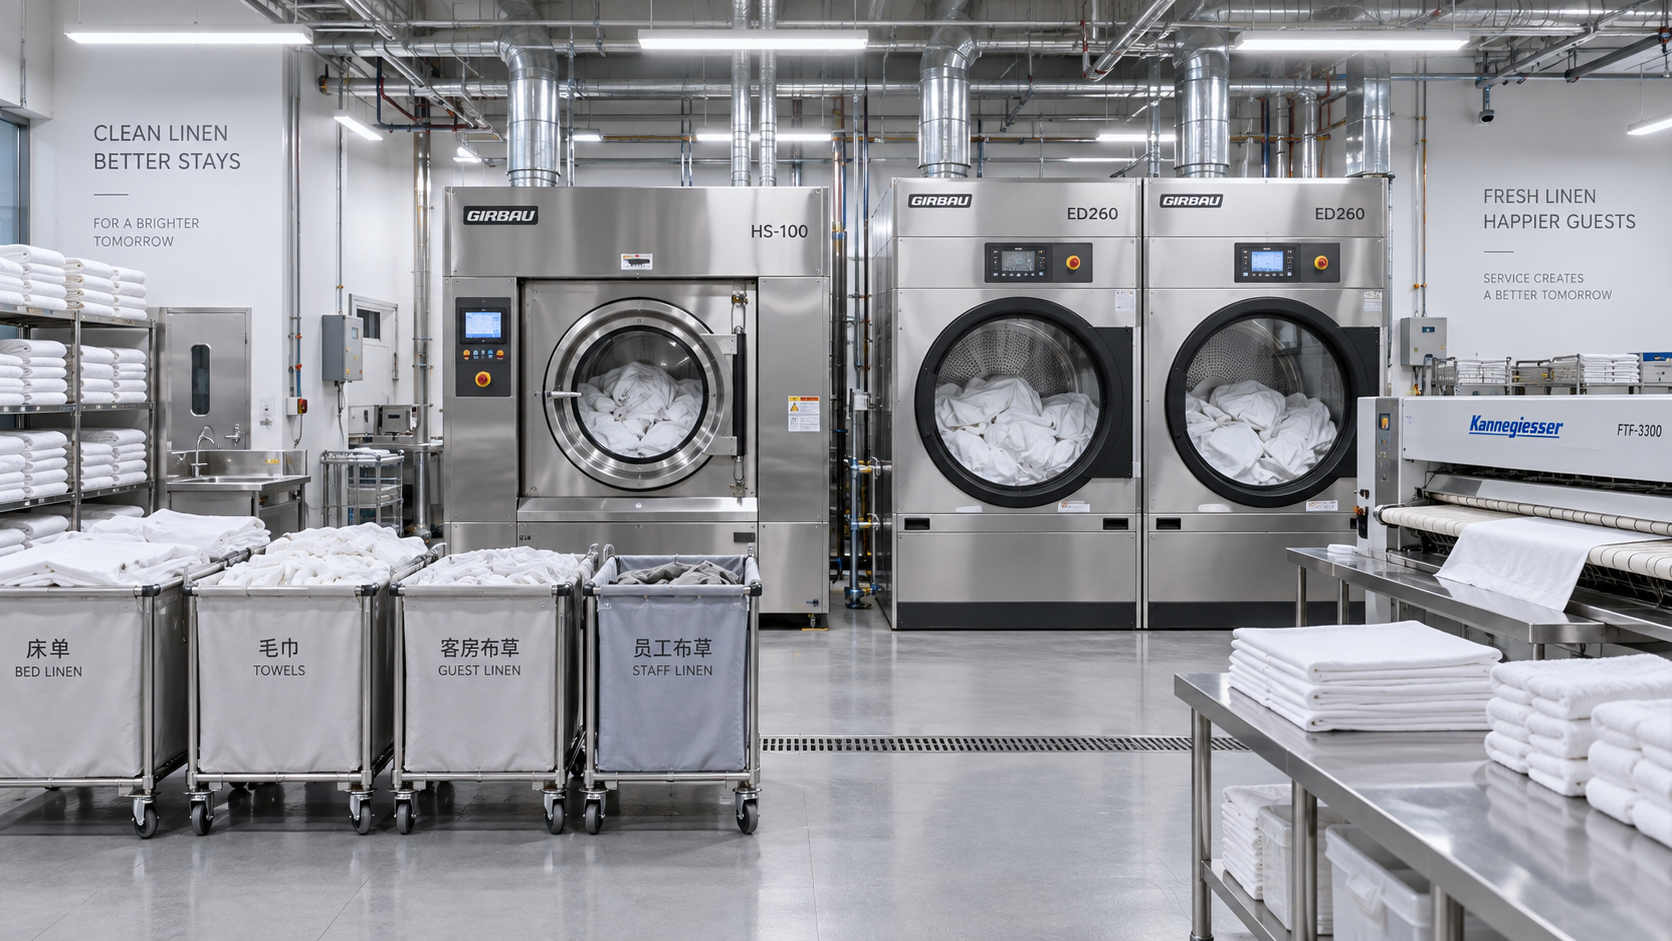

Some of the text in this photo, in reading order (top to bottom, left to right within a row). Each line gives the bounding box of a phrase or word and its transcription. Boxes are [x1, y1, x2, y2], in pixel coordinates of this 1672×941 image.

[93, 125, 227, 141] CLEAN LINEN
[94, 153, 240, 169] BETTER STAYS
[909, 196, 970, 208] GIRBAU
[1161, 196, 1221, 208] GIRBAU
[1484, 189, 1595, 203] FRESH LINEN
[465, 210, 536, 223] GIRBAU
[1067, 208, 1118, 221] ED260
[1315, 208, 1365, 221] ED260
[93, 218, 199, 229] FOR A BRIGHTER
[1484, 214, 1635, 229] HAPPIER GUESTS
[750, 224, 809, 239] HS-100
[93, 236, 174, 248] TOMORROW
[1483, 273, 1584, 284] SERVICE CREATES
[1483, 290, 1612, 301] A BETTER TOMORROW
[1468, 415, 1563, 438] Kannegiesser
[1617, 424, 1662, 437] FTF-3300
[26, 639, 69, 659] 床单
[258, 638, 298, 658] 毛巾
[440, 638, 519, 658] 客房布草
[633, 638, 712, 658] 员工布草
[15, 666, 82, 678] BED LINEN
[253, 665, 305, 677] TOWELS
[438, 665, 520, 677] GUEST LINEN
[632, 665, 712, 677] STAFF LINEN
